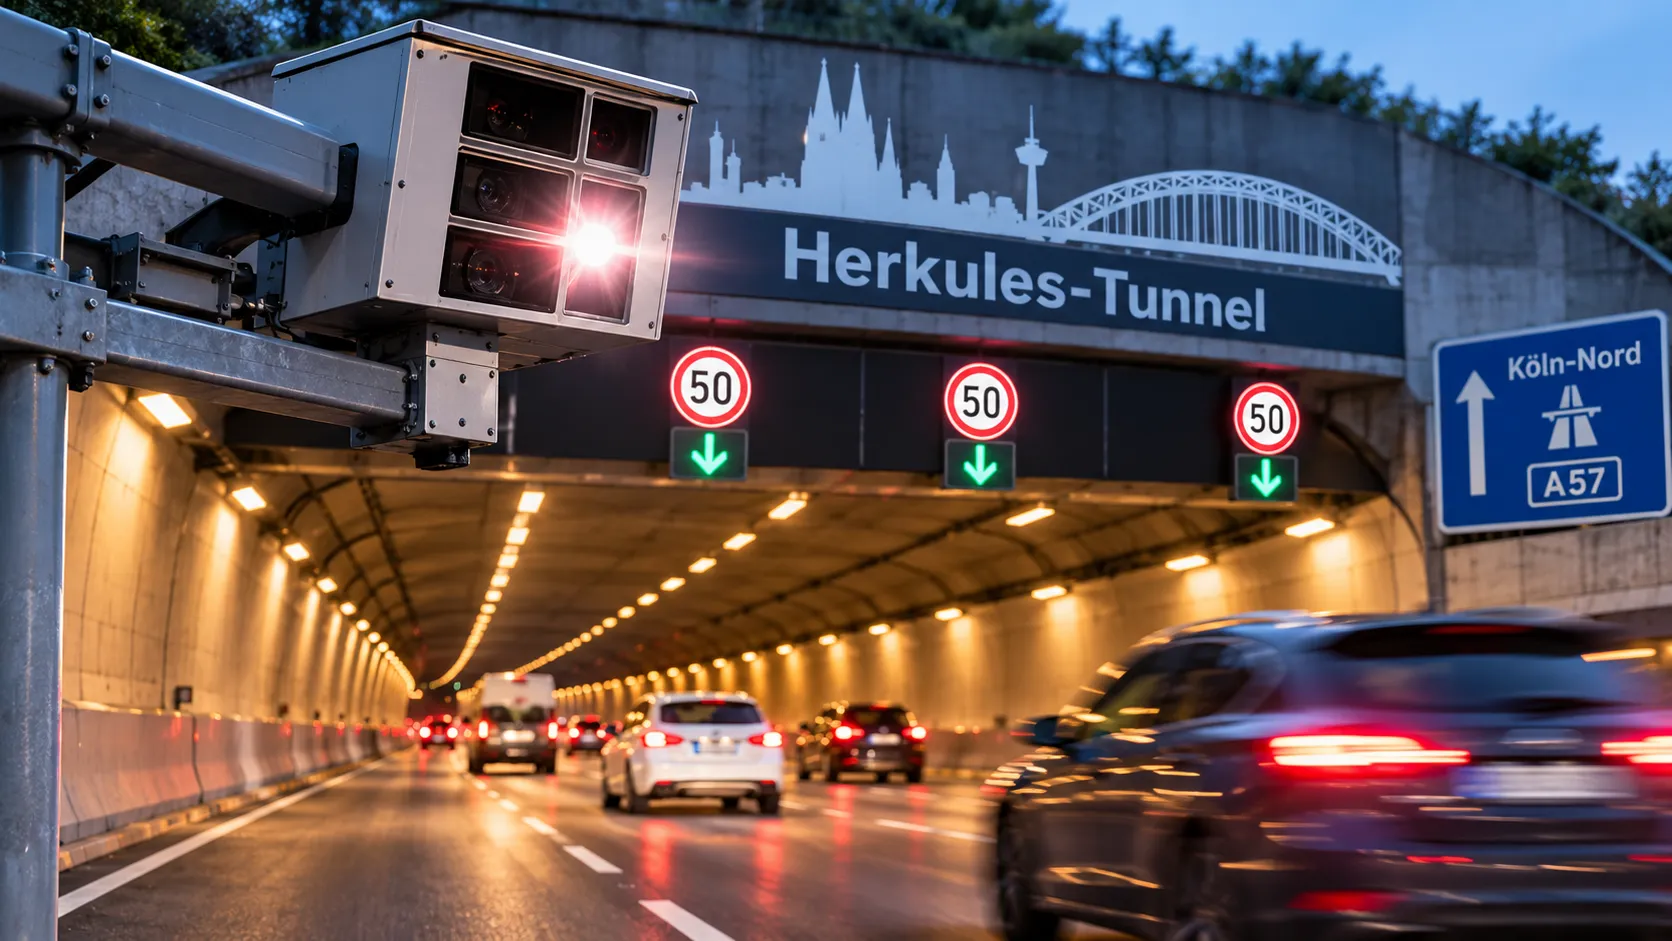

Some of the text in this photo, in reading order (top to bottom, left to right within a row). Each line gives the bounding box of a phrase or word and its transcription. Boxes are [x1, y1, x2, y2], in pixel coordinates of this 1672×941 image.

[784, 227, 1266, 332] Herkules-Tunnel
[1508, 340, 1641, 381] Köln-Nord
[690, 371, 732, 405] 50
[962, 385, 1001, 419] 50
[1250, 403, 1284, 435] 50
[1543, 467, 1605, 498] A57
